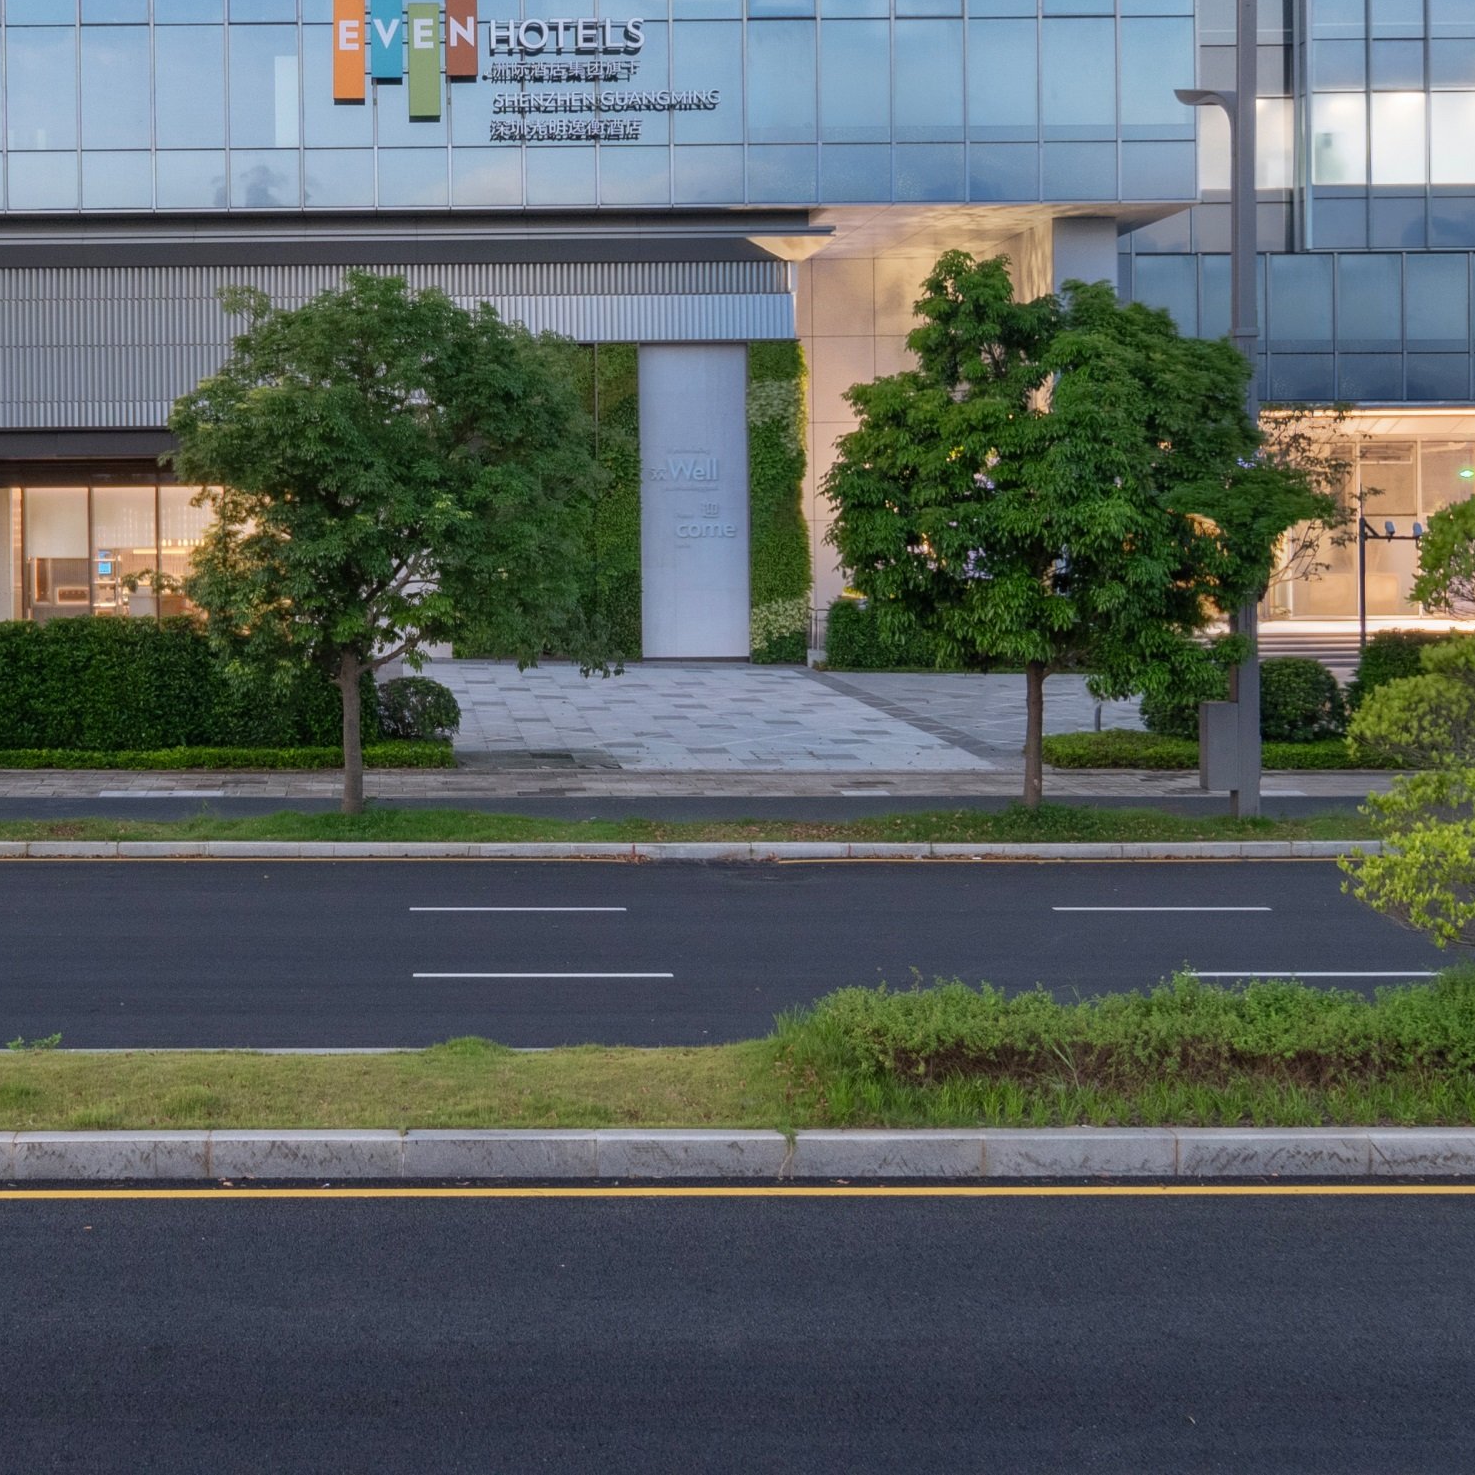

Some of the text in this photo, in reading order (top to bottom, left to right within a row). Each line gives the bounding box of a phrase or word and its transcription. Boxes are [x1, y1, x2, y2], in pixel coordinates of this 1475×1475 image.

[338, 16, 646, 51] EVEN HOTELS
[493, 60, 641, 78] 洲际酒店集团旗下
[494, 89, 721, 108] SHENZHEN GUANGMING
[491, 118, 643, 135] 深圳光明逸衡酒店
[667, 458, 719, 481] Well
[677, 523, 736, 538] come
